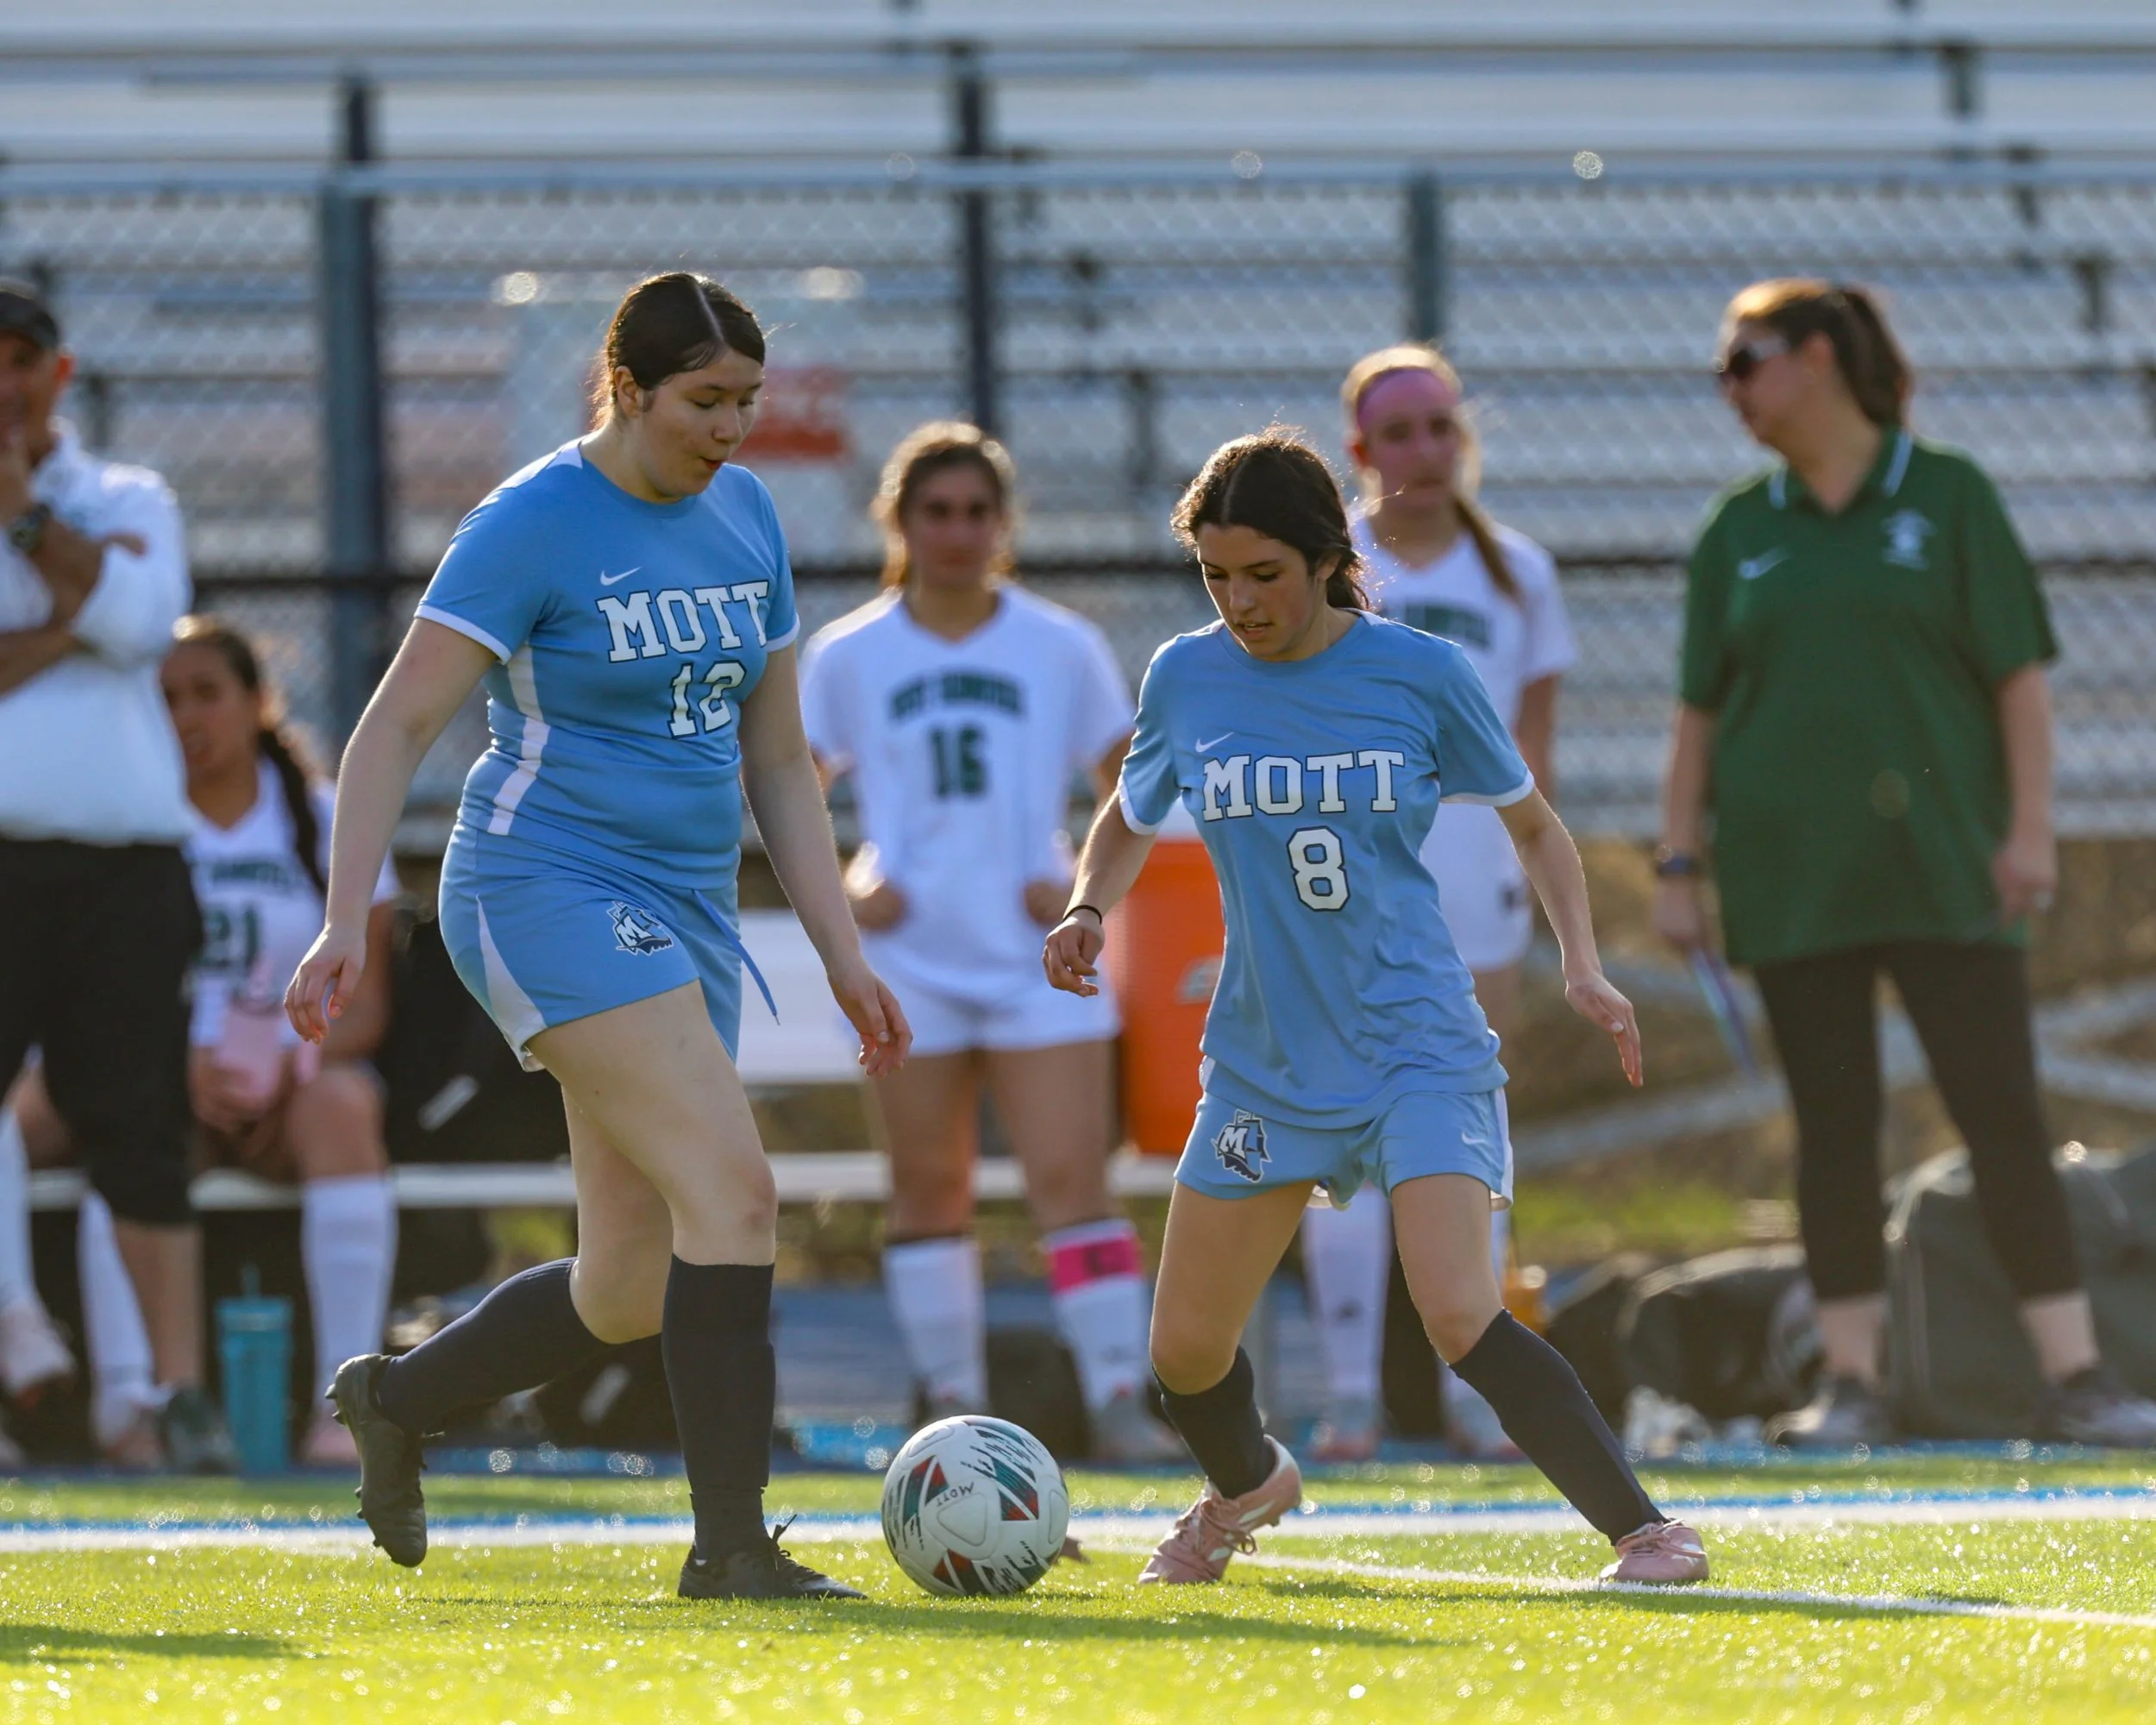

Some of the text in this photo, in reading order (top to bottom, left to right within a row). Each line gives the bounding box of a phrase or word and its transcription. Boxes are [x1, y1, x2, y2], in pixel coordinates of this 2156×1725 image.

[595, 580, 769, 663] MOTT
[667, 660, 747, 739] 12
[930, 726, 987, 797] 16
[1202, 749, 1406, 822] MOTT
[1286, 825, 1351, 912] 8
[936, 1481, 975, 1508] MOTT
